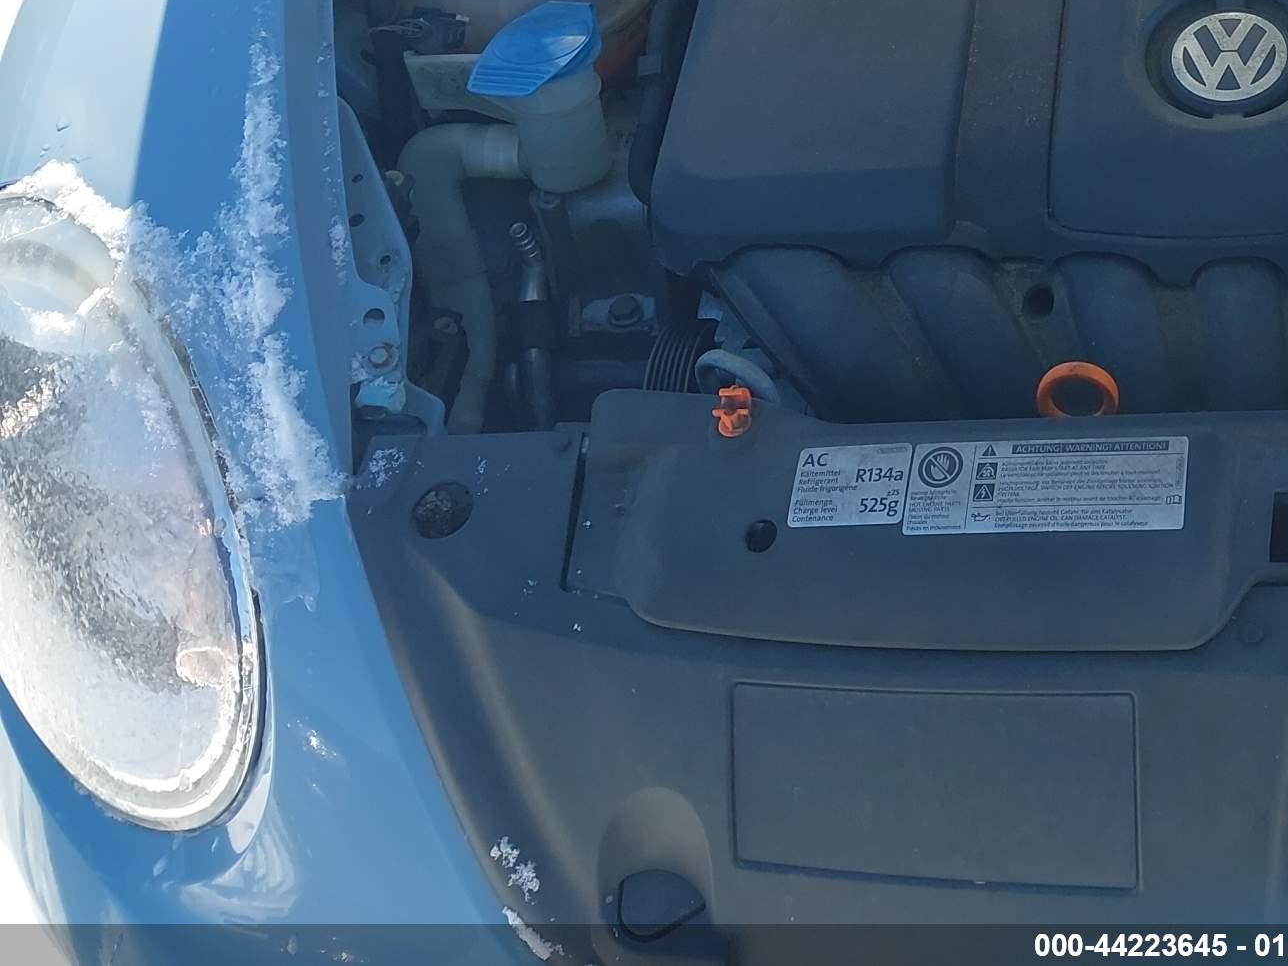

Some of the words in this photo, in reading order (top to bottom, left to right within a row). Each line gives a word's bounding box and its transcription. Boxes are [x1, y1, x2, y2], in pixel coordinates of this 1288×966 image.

[1175, 14, 1284, 98] VW
[1016, 444, 1062, 453] ACHTUNG!
[1065, 443, 1111, 452] WARNING!
[1113, 441, 1167, 451] ATTENTION!
[802, 452, 829, 467] AC
[799, 477, 840, 486] Refrigerant
[856, 467, 904, 482] R134a
[859, 497, 899, 517] 525g
